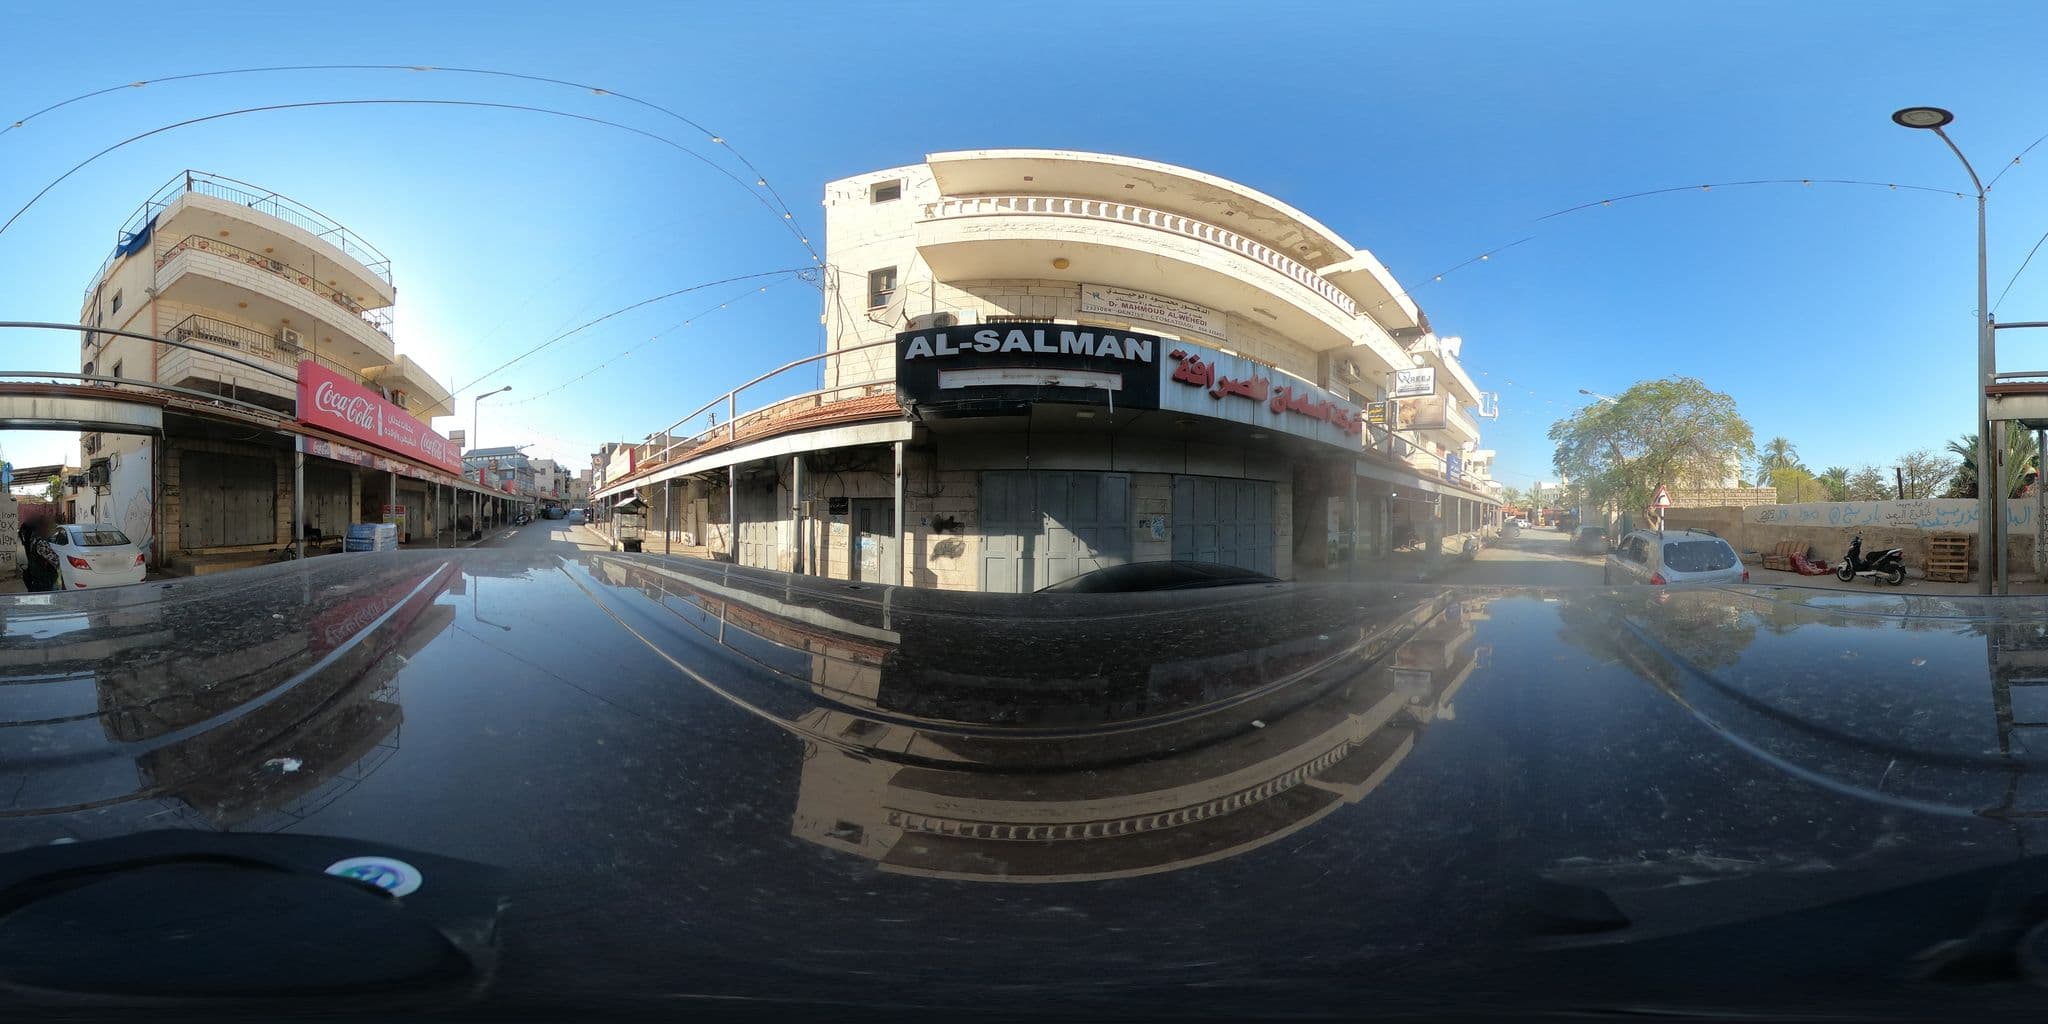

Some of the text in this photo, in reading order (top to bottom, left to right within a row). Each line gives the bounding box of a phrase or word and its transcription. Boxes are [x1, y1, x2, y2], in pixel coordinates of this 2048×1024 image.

[1108, 300, 1118, 308] Dr
[1121, 302, 1165, 316] MAHMOUD
[905, 329, 1152, 362] AL-SALMAN
[315, 380, 376, 431] Coca-Cola
